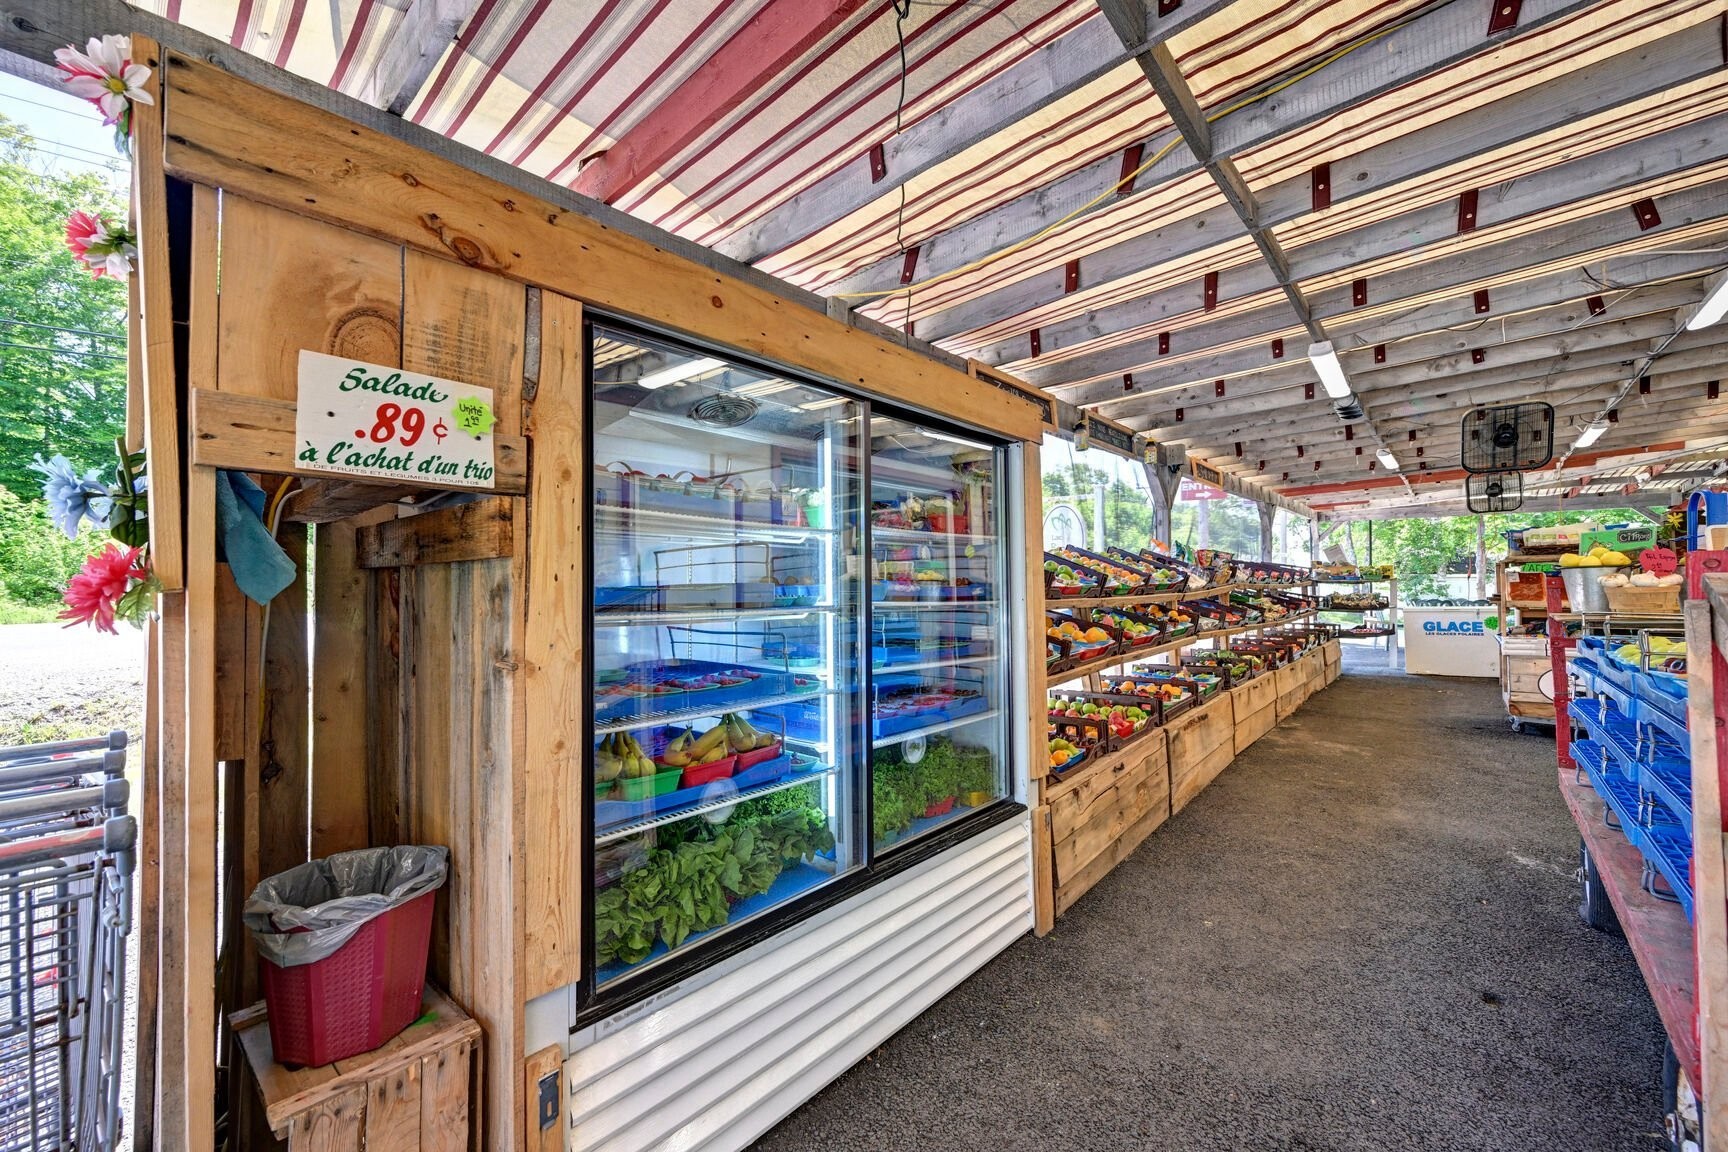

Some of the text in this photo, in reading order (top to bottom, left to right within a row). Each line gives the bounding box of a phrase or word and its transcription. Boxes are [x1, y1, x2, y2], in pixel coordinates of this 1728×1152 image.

[338, 367, 449, 403] Salade
[298, 440, 494, 481] à l'achat d'un trio
[330, 465, 367, 475] FRUITS
[1423, 621, 1484, 633] GLACE
